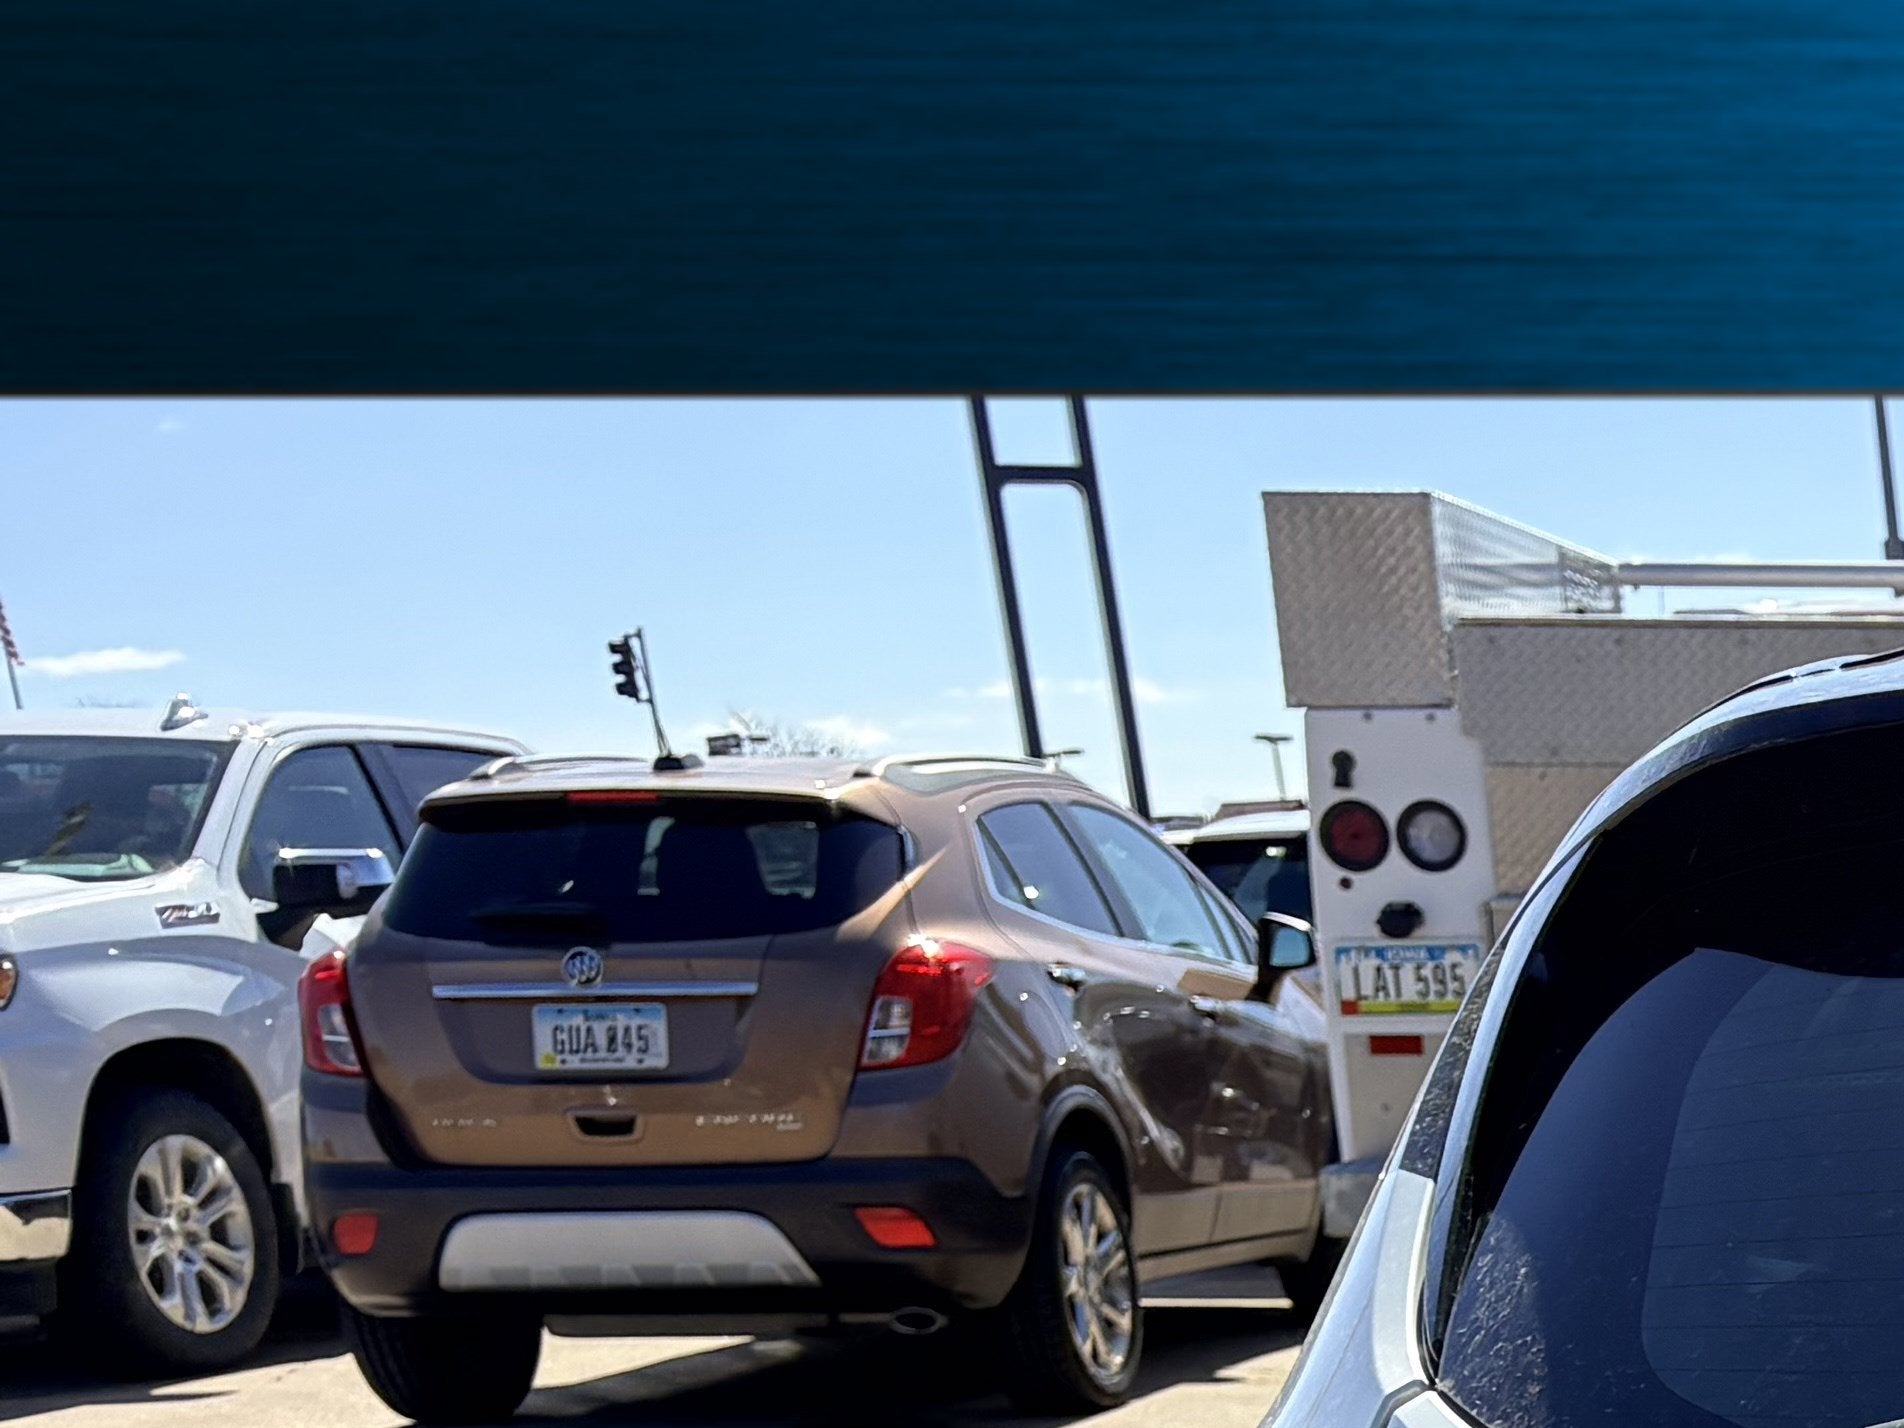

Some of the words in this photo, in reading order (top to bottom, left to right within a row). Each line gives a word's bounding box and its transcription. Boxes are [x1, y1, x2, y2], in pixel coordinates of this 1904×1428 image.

[1351, 961, 1402, 999] LAT
[1414, 961, 1467, 999] 595
[551, 1024, 598, 1055] GUA
